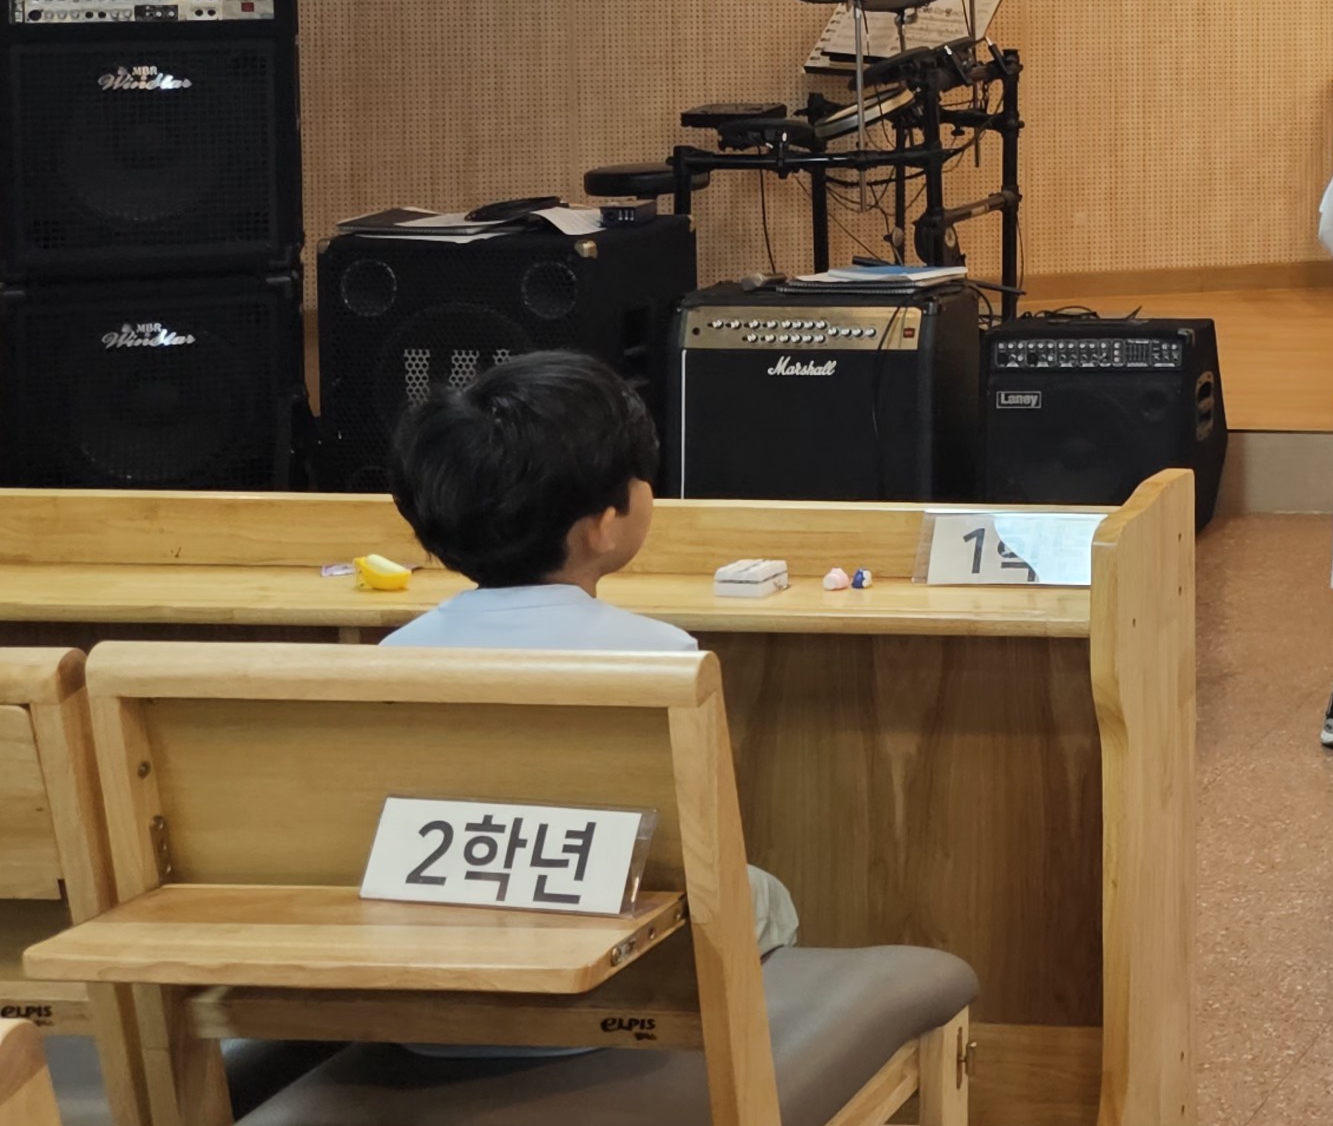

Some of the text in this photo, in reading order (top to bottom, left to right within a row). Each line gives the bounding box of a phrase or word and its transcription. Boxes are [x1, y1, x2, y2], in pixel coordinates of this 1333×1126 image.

[767, 355, 837, 377] Marshall
[1000, 392, 1039, 408] Laney
[405, 813, 597, 905] 2학년
